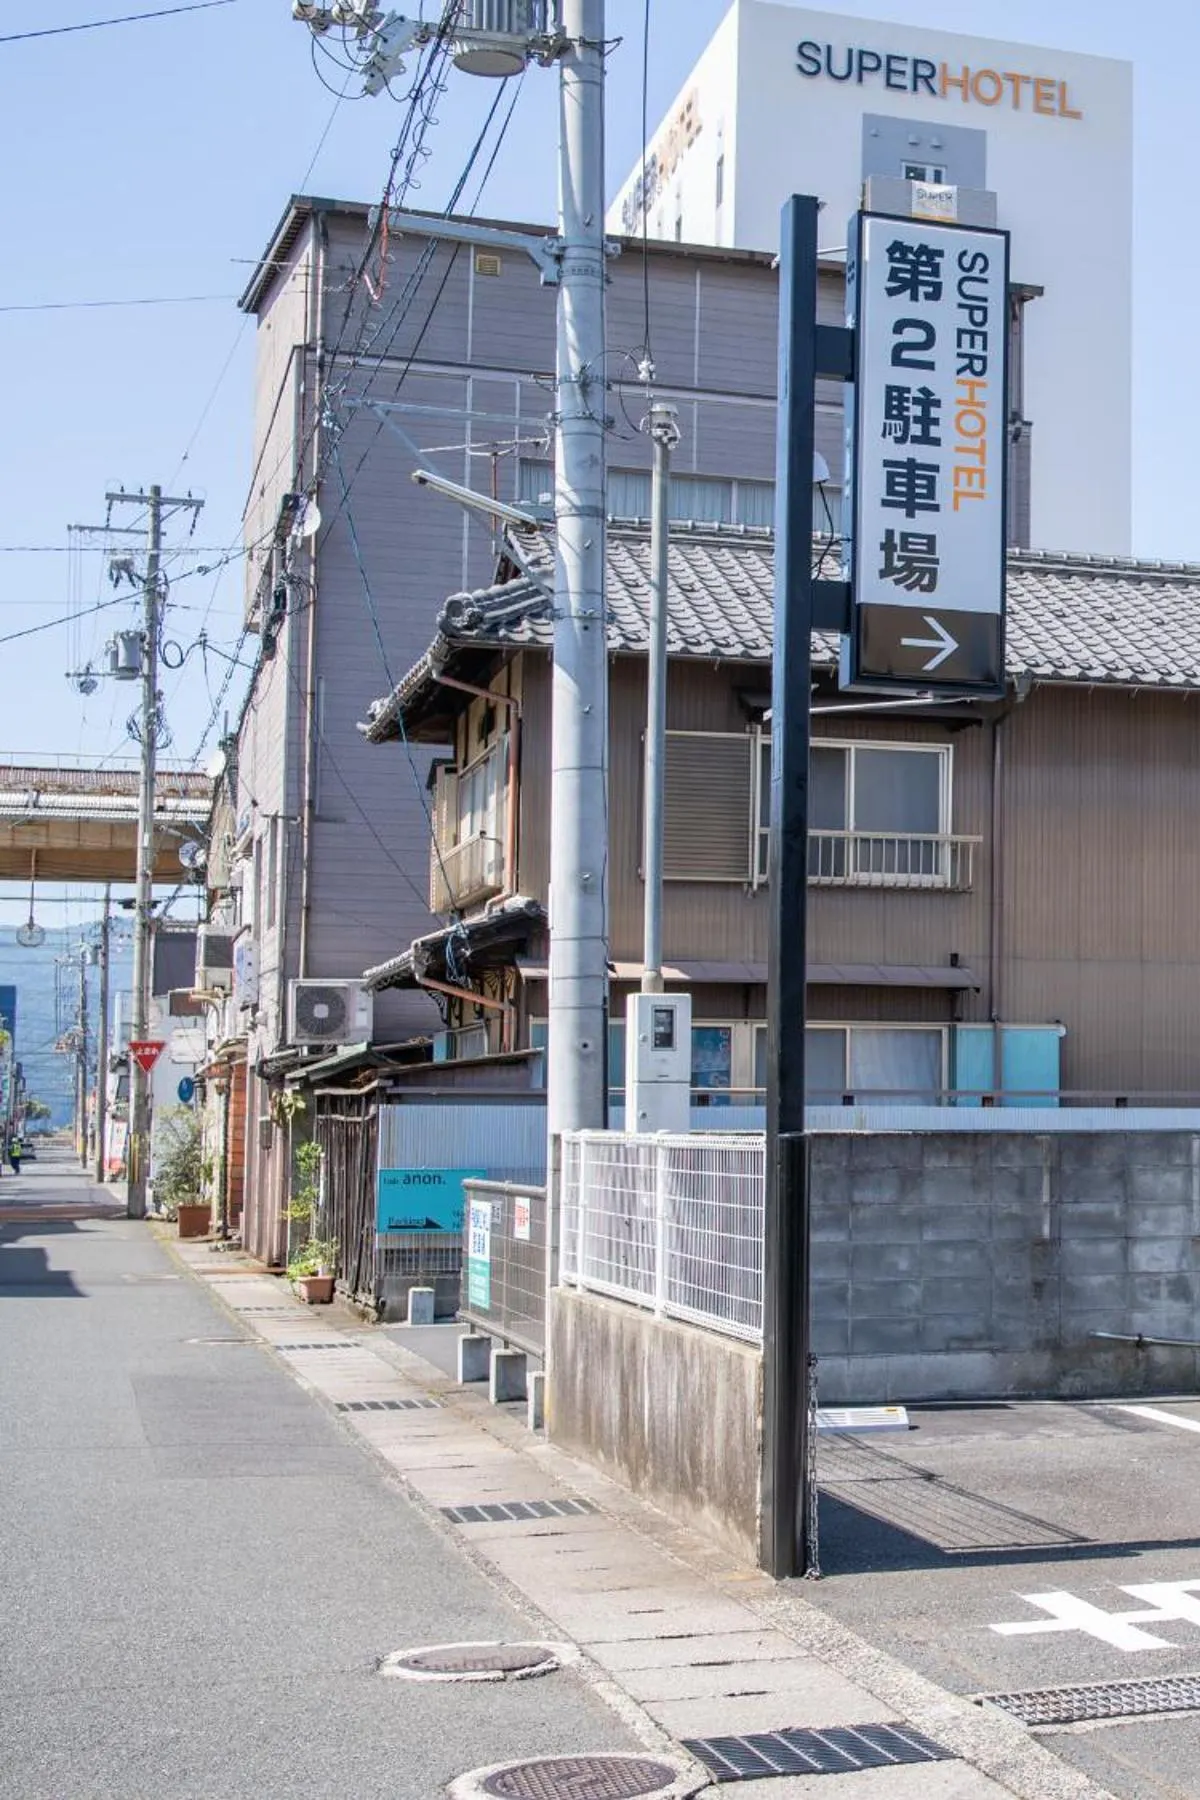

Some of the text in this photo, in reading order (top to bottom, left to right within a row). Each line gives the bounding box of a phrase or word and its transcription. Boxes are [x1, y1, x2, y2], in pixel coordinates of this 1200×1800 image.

[796, 41, 1083, 120] SUPERHOTEL
[878, 240, 944, 592] 第2駐車場
[953, 249, 989, 512] SUPERHOTEL
